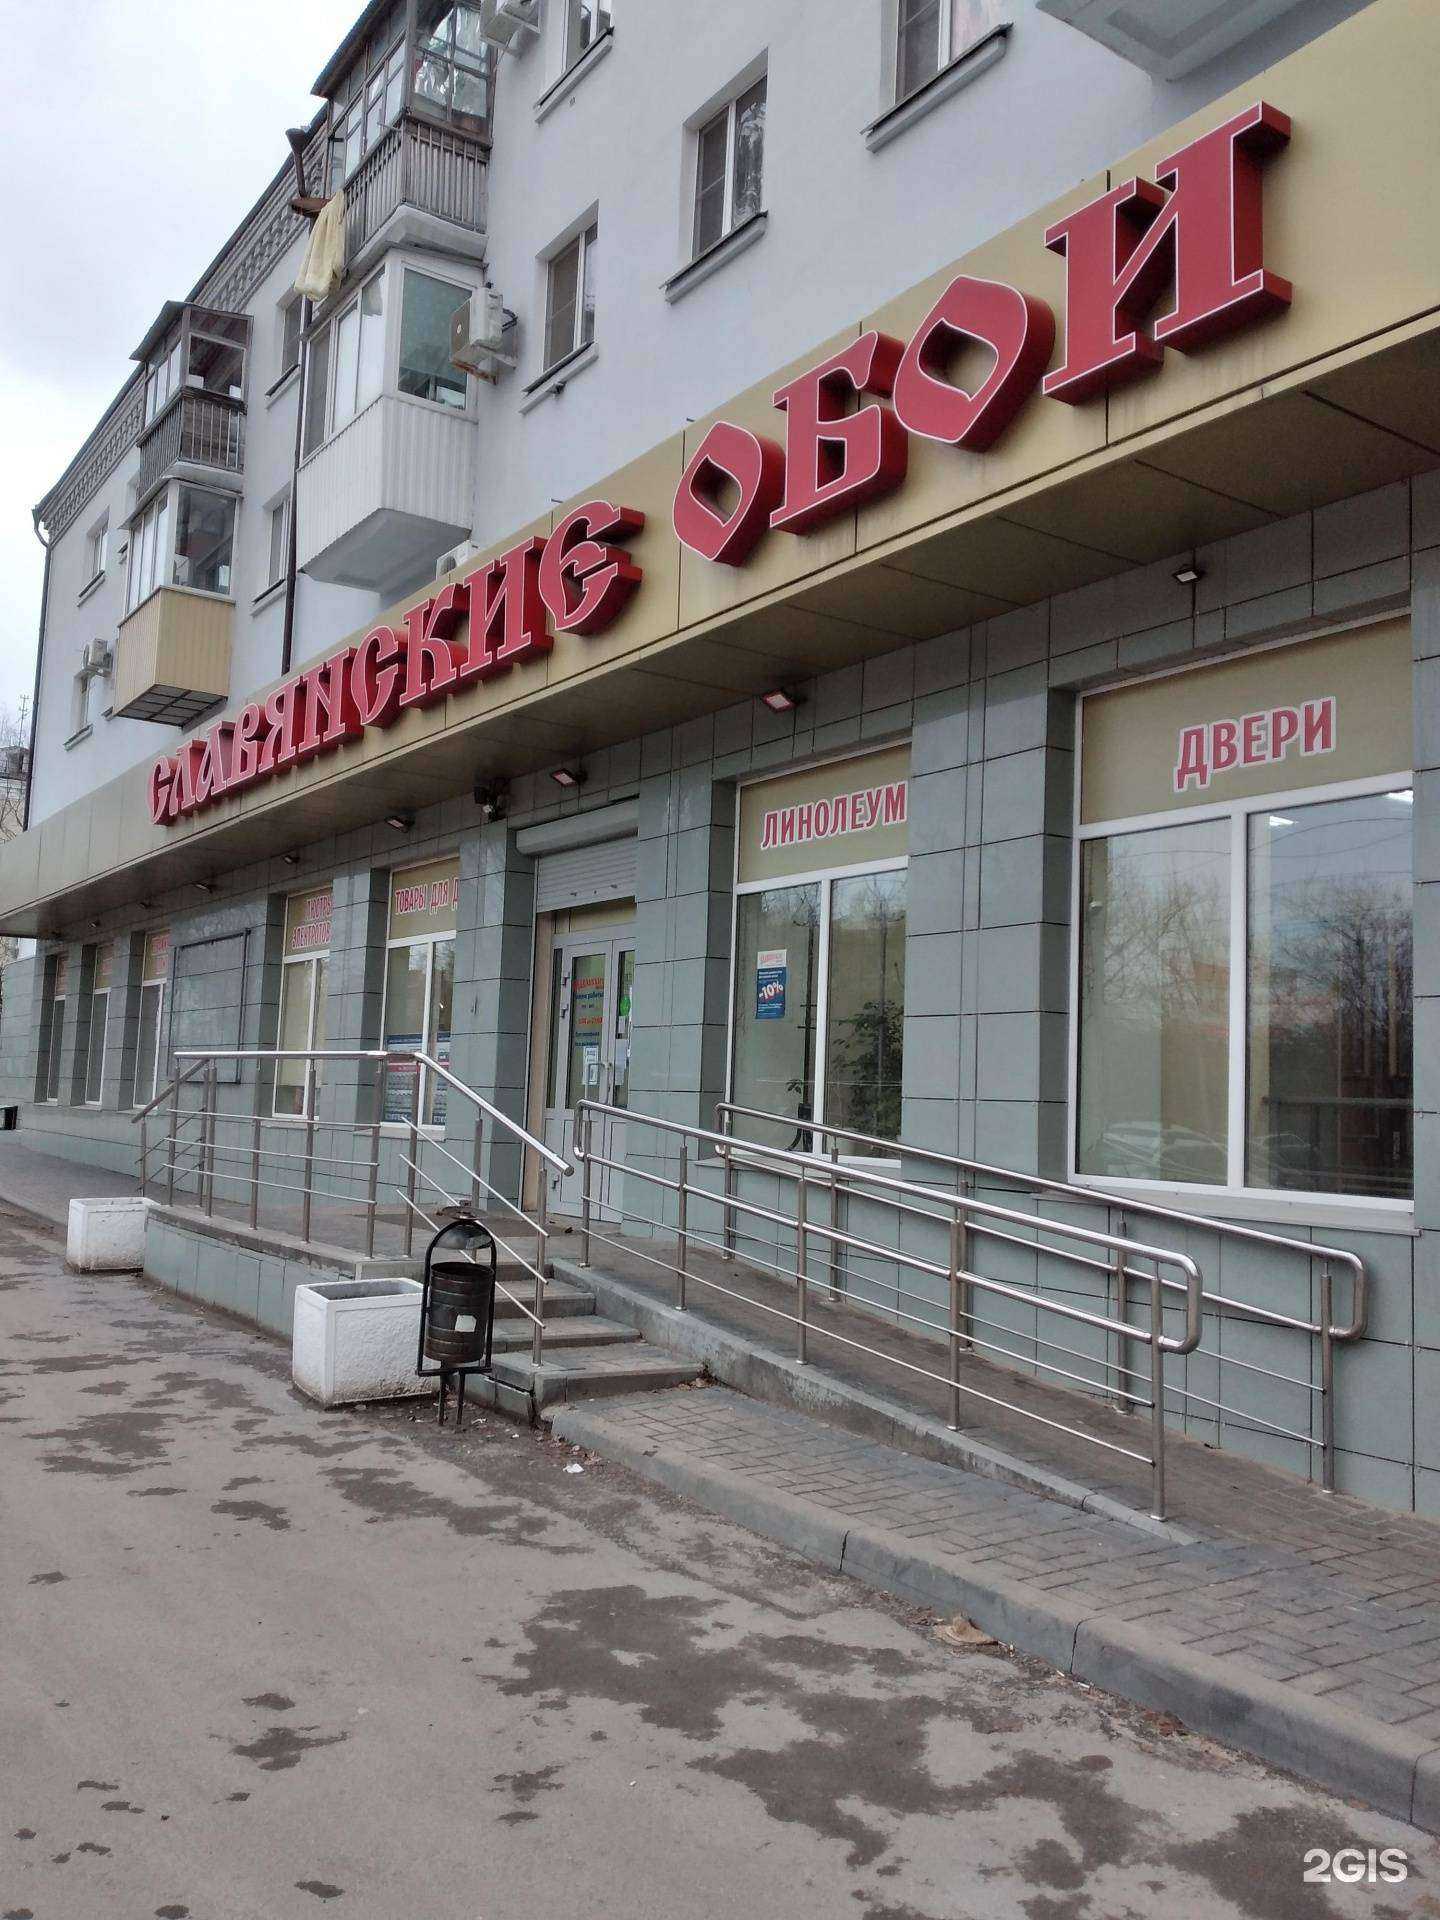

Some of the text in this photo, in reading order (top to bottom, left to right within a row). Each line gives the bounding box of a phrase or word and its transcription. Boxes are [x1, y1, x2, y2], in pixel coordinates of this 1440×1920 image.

[673, 100, 1292, 567] ОБОИ
[1173, 696, 1336, 792] ДВЕРИ
[760, 780, 909, 850] ЛИНОЛЕУМ
[394, 884, 427, 915] ТОВАРЫ
[430, 879, 450, 915] ДЛЯ
